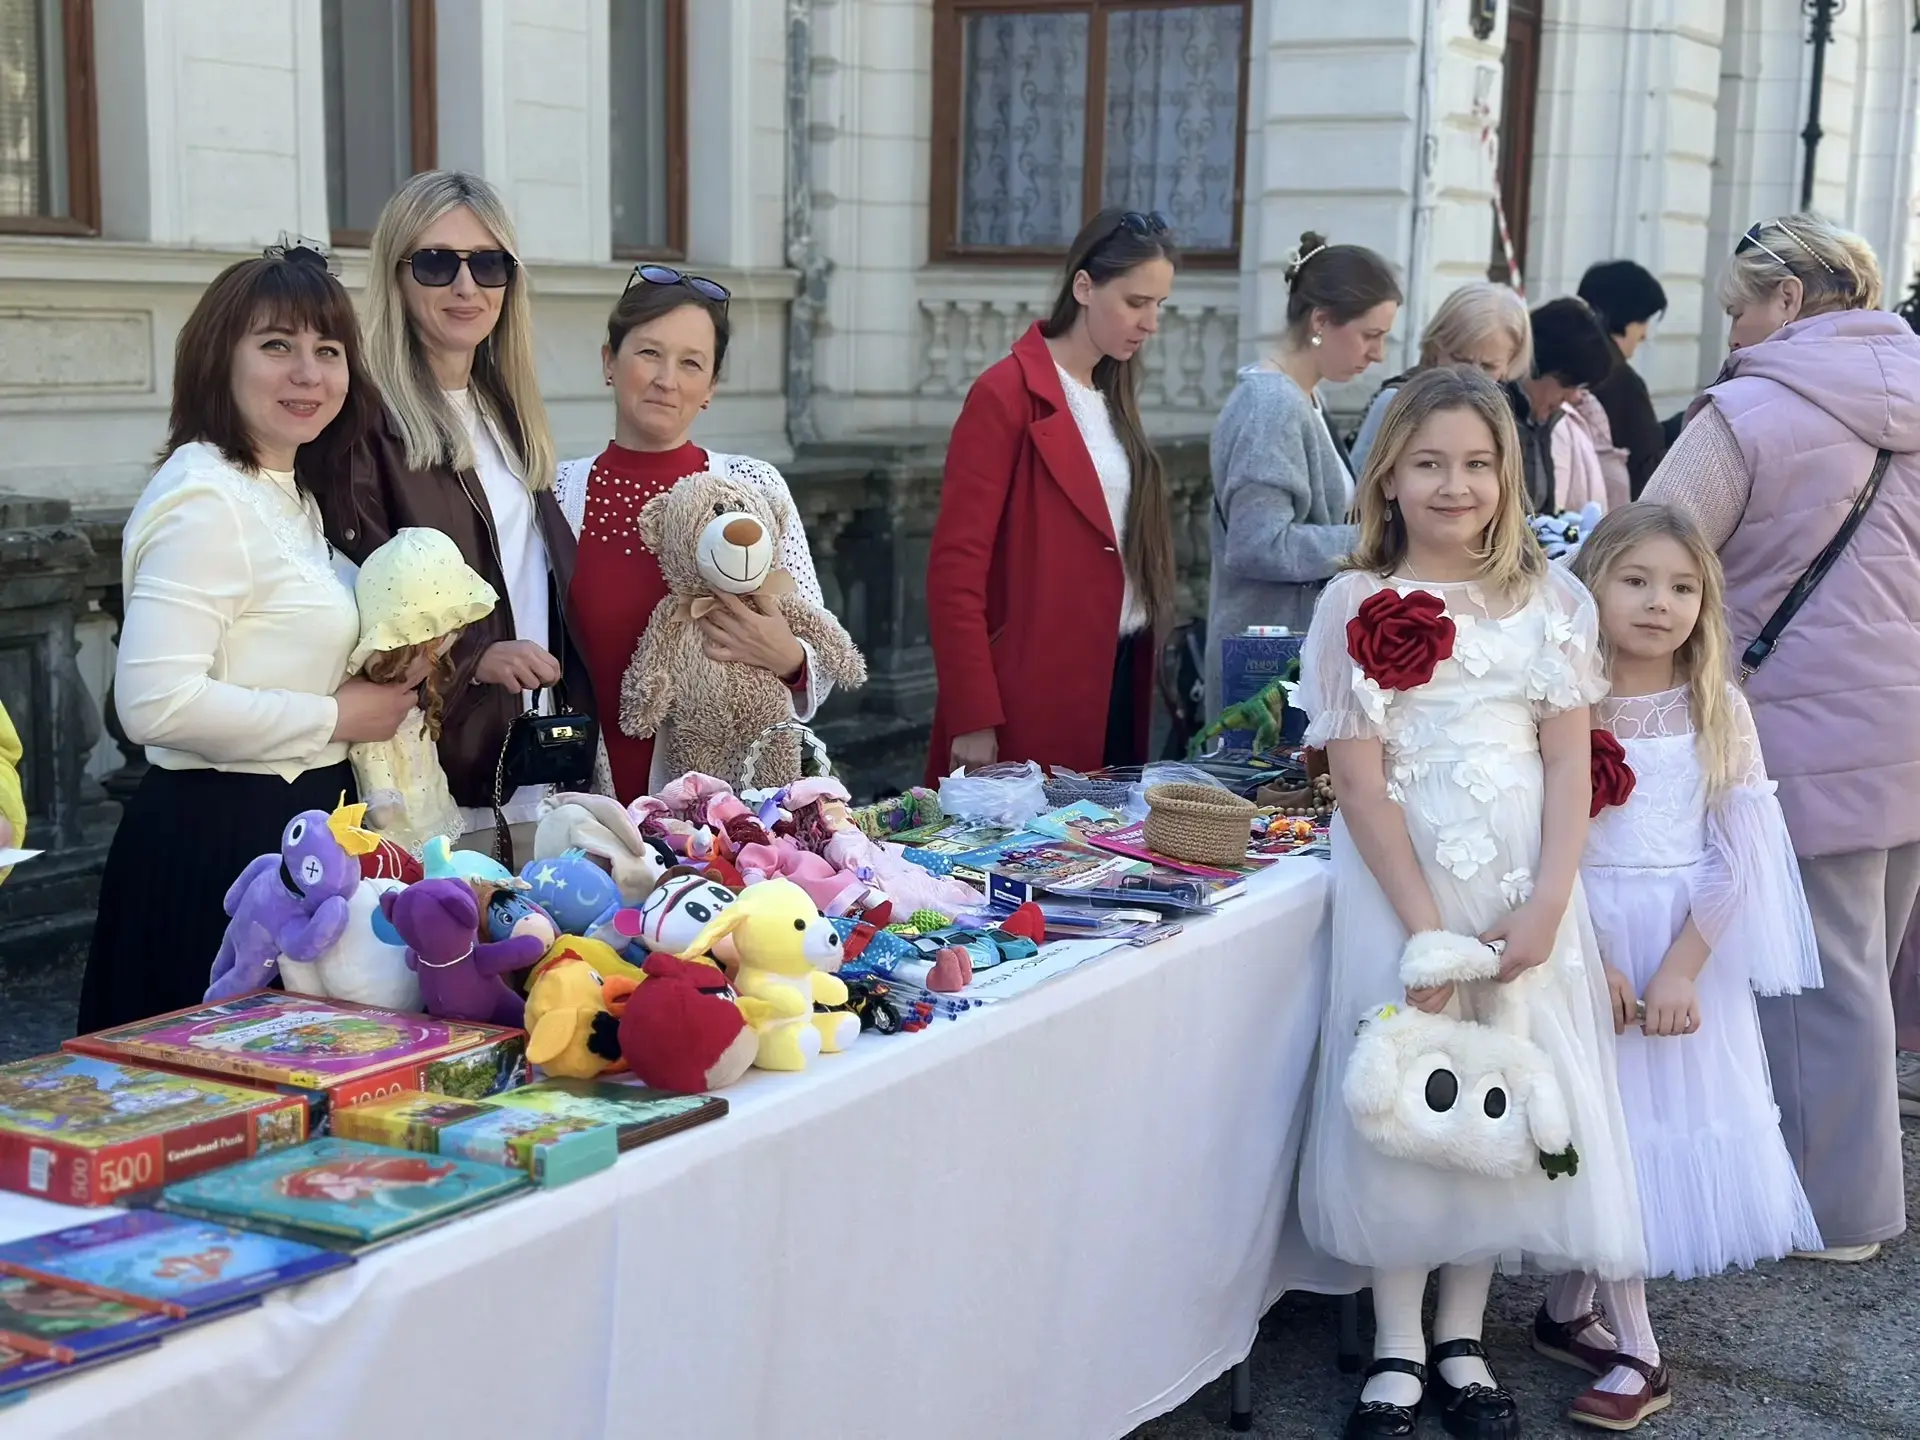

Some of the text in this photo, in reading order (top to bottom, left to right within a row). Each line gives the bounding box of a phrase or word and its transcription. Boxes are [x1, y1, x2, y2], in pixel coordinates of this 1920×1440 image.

[167, 1133, 246, 1163] Castorland Puzzle
[71, 1157, 89, 1200] 500
[100, 1152, 152, 1194] 500
